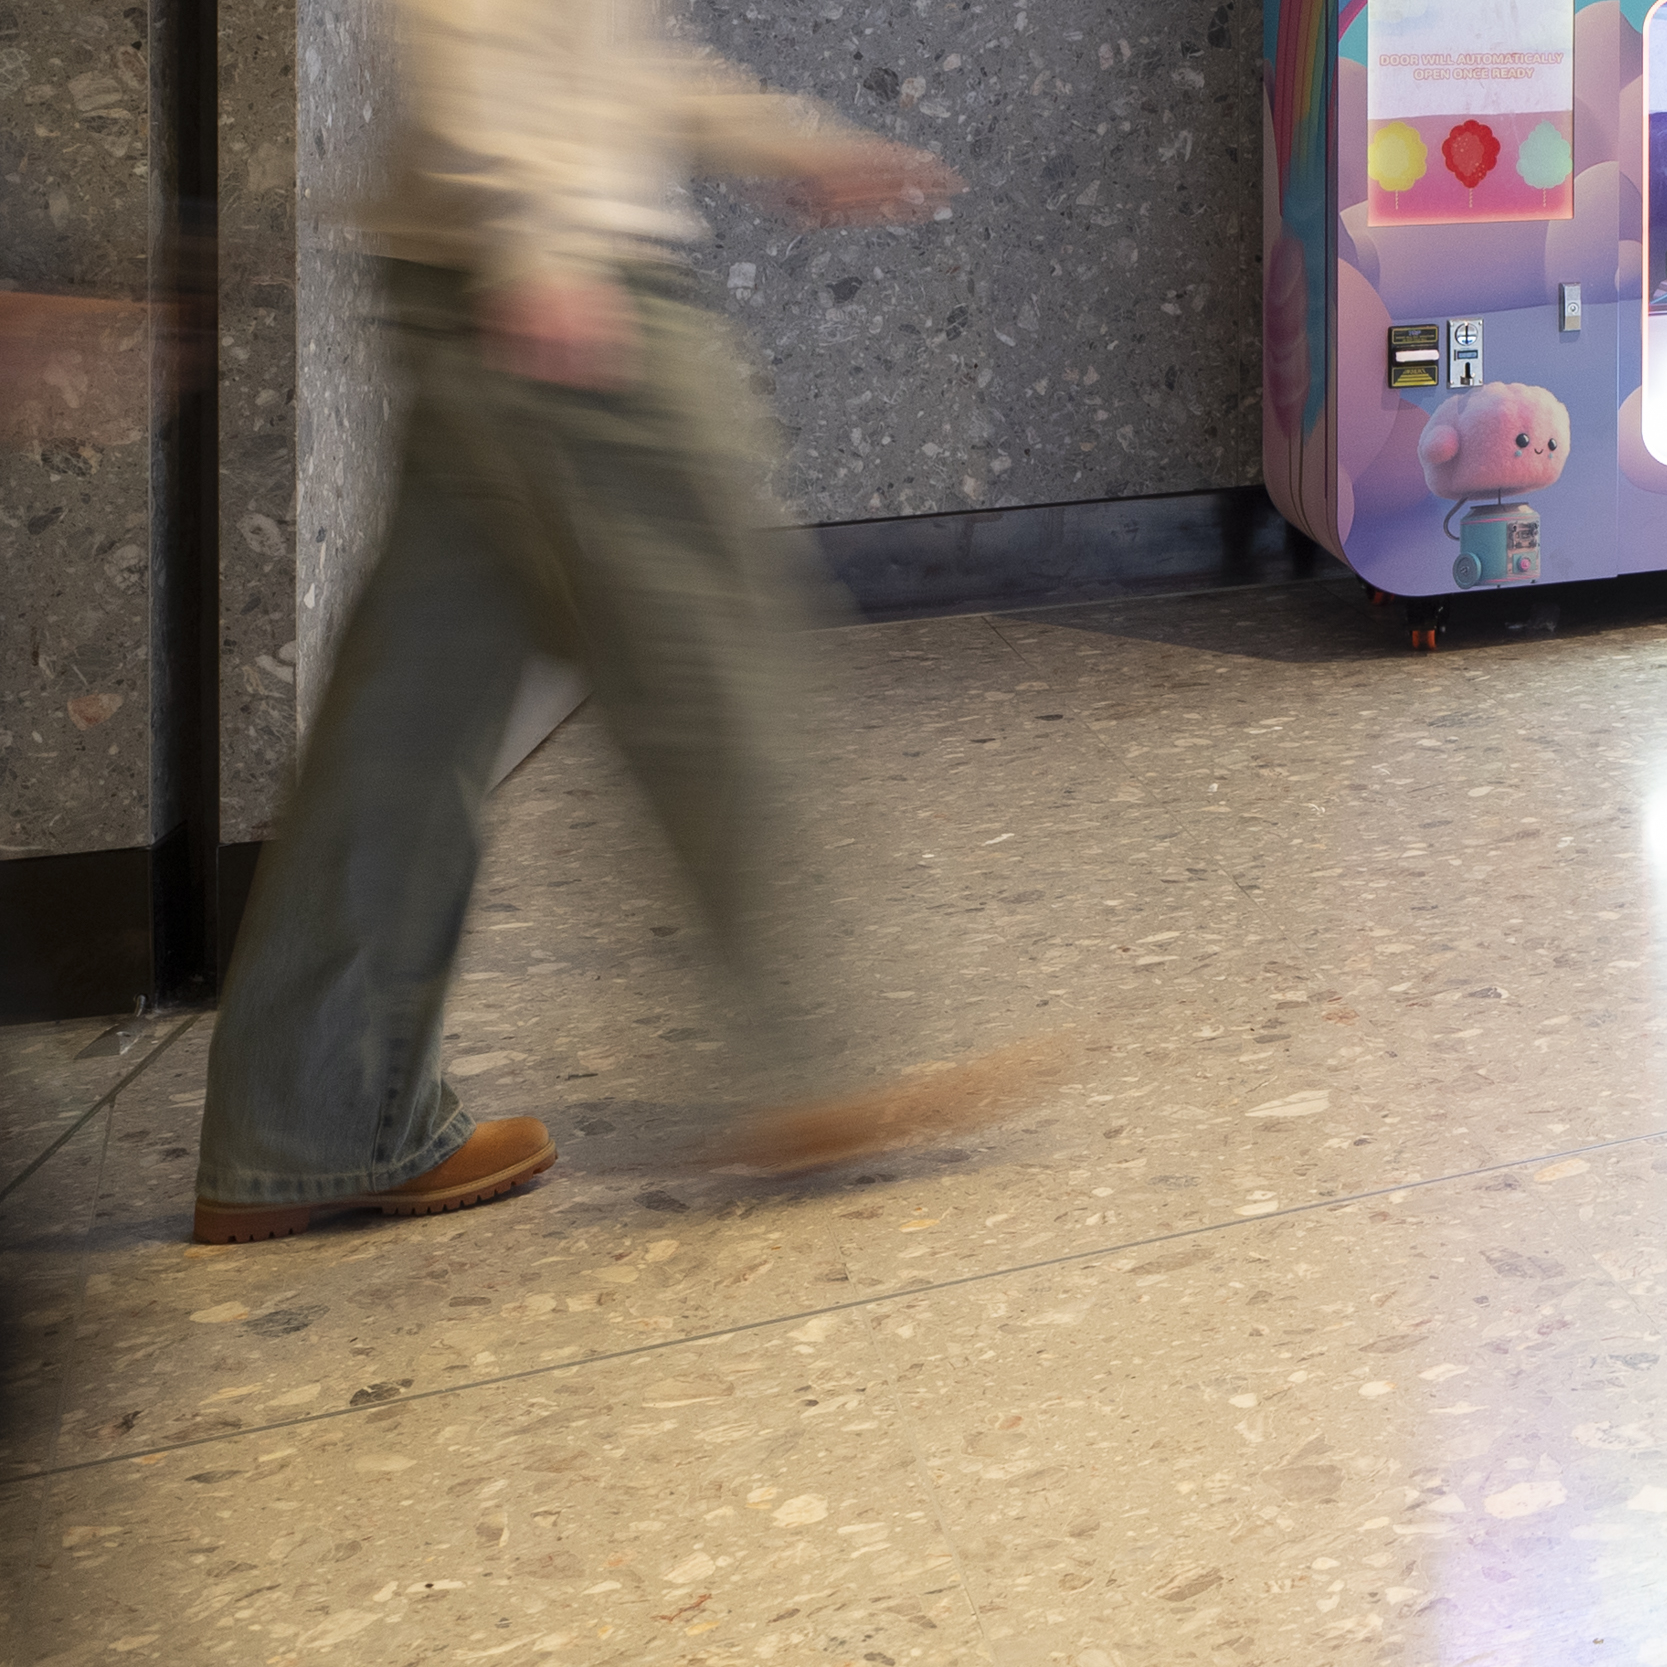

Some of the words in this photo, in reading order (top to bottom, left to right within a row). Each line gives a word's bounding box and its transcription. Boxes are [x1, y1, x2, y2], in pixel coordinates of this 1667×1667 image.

[1379, 54, 1419, 66] DOOR
[1422, 53, 1454, 66] WILL
[1457, 52, 1564, 65] AUTOMATICALLY
[1413, 68, 1450, 80] OPEN
[1452, 68, 1488, 80] ONCE
[1491, 67, 1535, 80] READY
